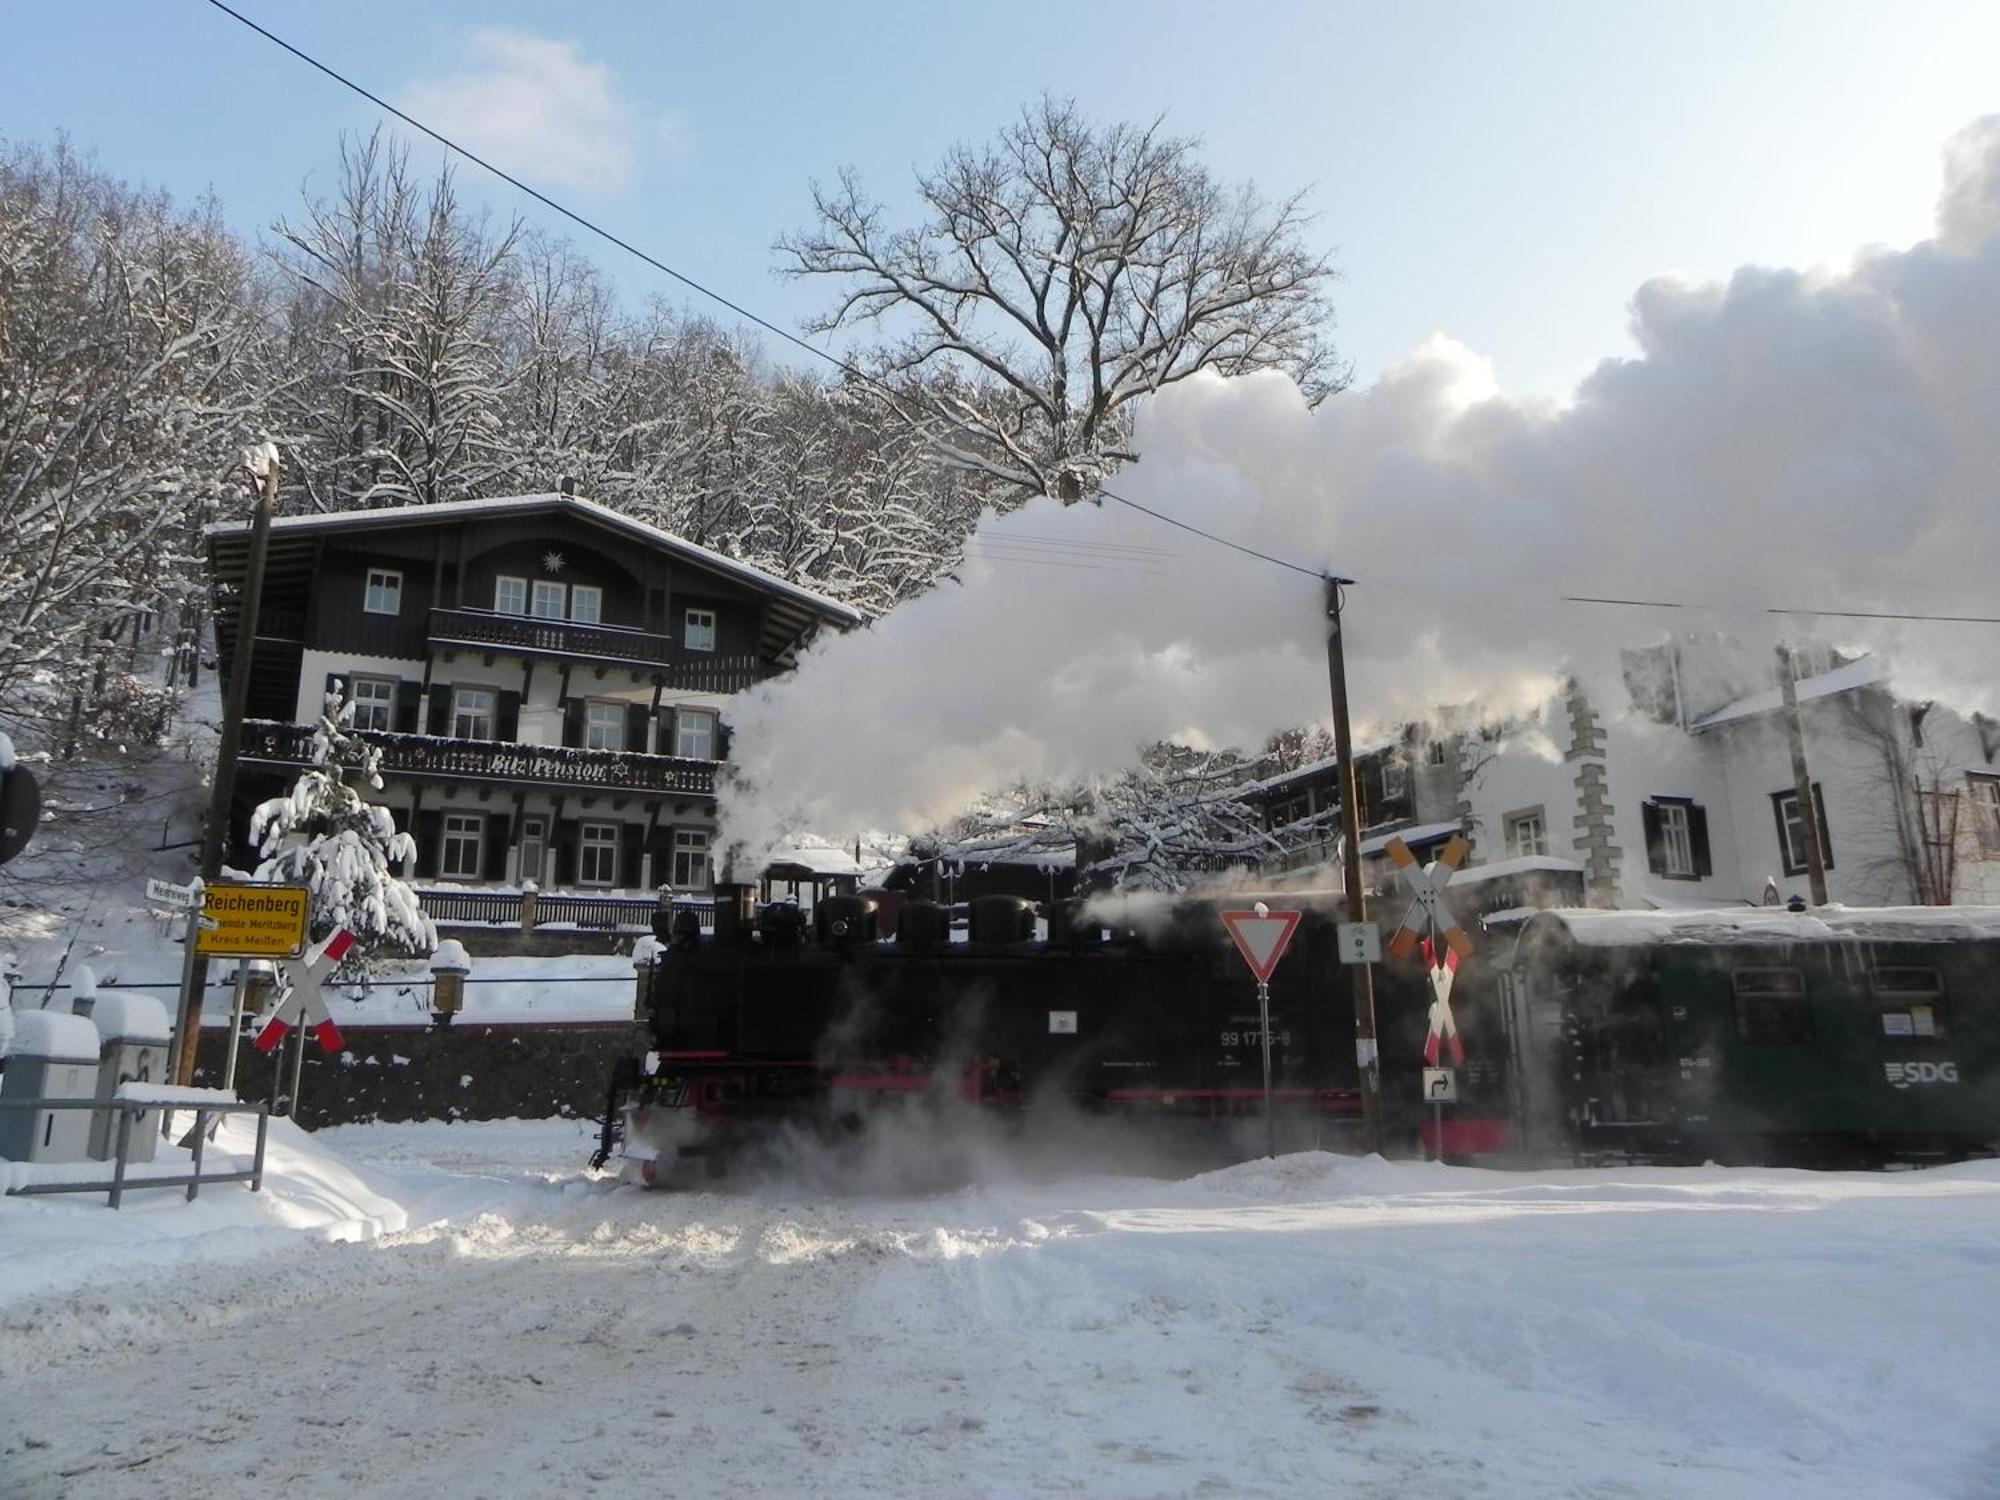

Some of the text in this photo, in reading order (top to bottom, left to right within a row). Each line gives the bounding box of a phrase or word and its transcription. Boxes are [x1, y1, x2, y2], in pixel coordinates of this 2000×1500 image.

[533, 757, 607, 778] Pension
[205, 893, 300, 916] Reichenberg
[249, 919, 297, 932] Moritzburg
[211, 935, 285, 946] Kreis Meißen
[1220, 1031, 1239, 1047] 99
